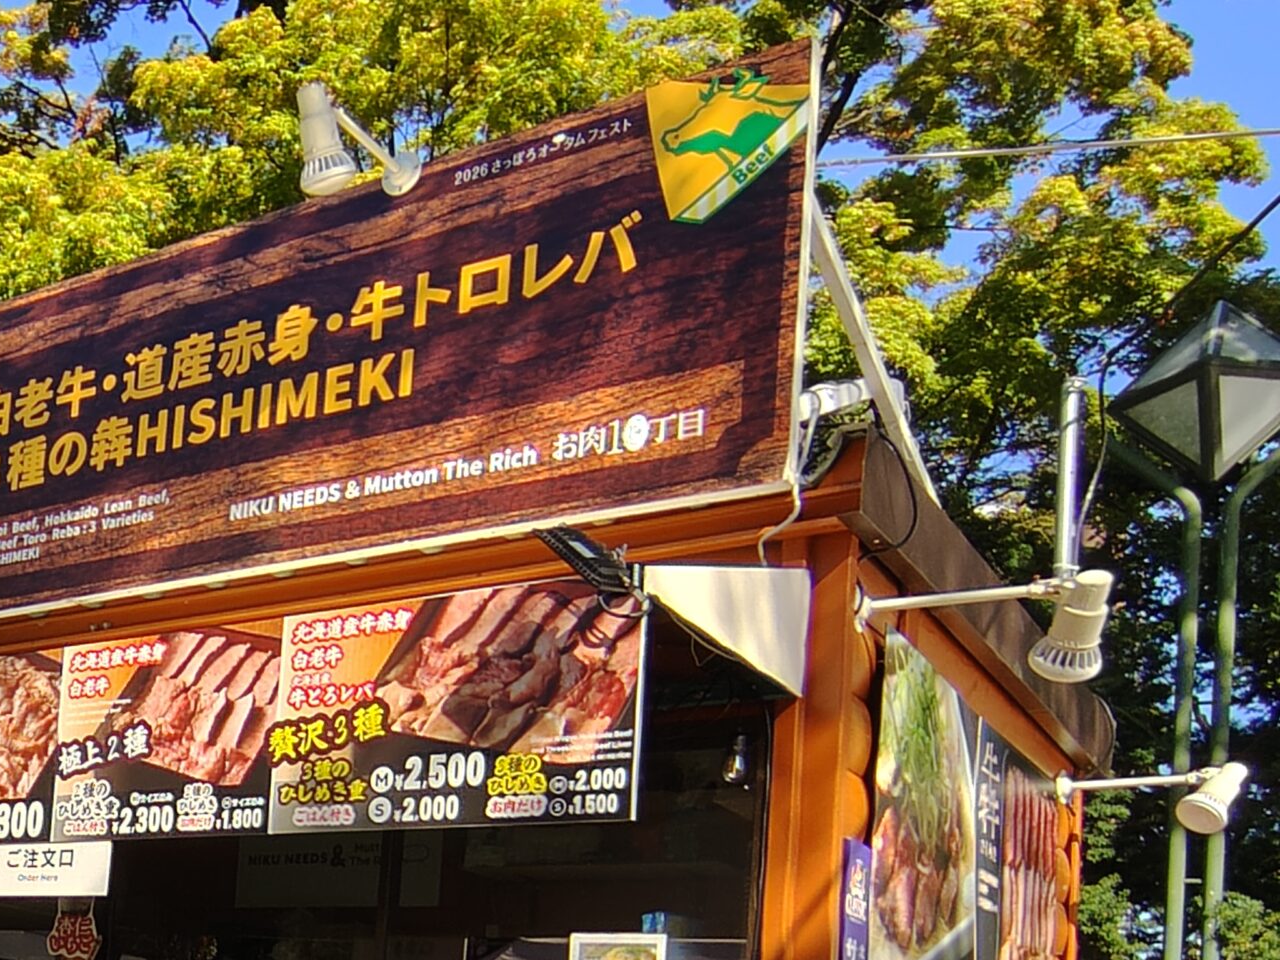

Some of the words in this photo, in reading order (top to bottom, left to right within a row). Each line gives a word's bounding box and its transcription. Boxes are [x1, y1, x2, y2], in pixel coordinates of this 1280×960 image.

[453, 162, 489, 186] 2026
[730, 142, 776, 187] Beef
[228, 495, 274, 522] NIKU
[277, 482, 341, 513] NEEDS
[344, 480, 361, 499] &
[363, 466, 439, 497] Mutton
[442, 457, 483, 482] The
[487, 445, 538, 472] Rich
[11, 517, 41, 534] Beef,
[44, 506, 99, 528] Hokkaido
[103, 500, 134, 515] Lean
[138, 489, 171, 506] Beef,
[22, 532, 49, 548] Toro
[101, 509, 155, 532] Varieties
[291, 646, 343, 672] 白老牛
[68, 677, 111, 700] 白老牛
[393, 751, 486, 793] ¥2,500
[111, 805, 174, 835] ¥2,300
[214, 808, 263, 831] ¥1,800
[393, 795, 460, 823] ¥2,000
[6, 847, 75, 870] ご注文口
